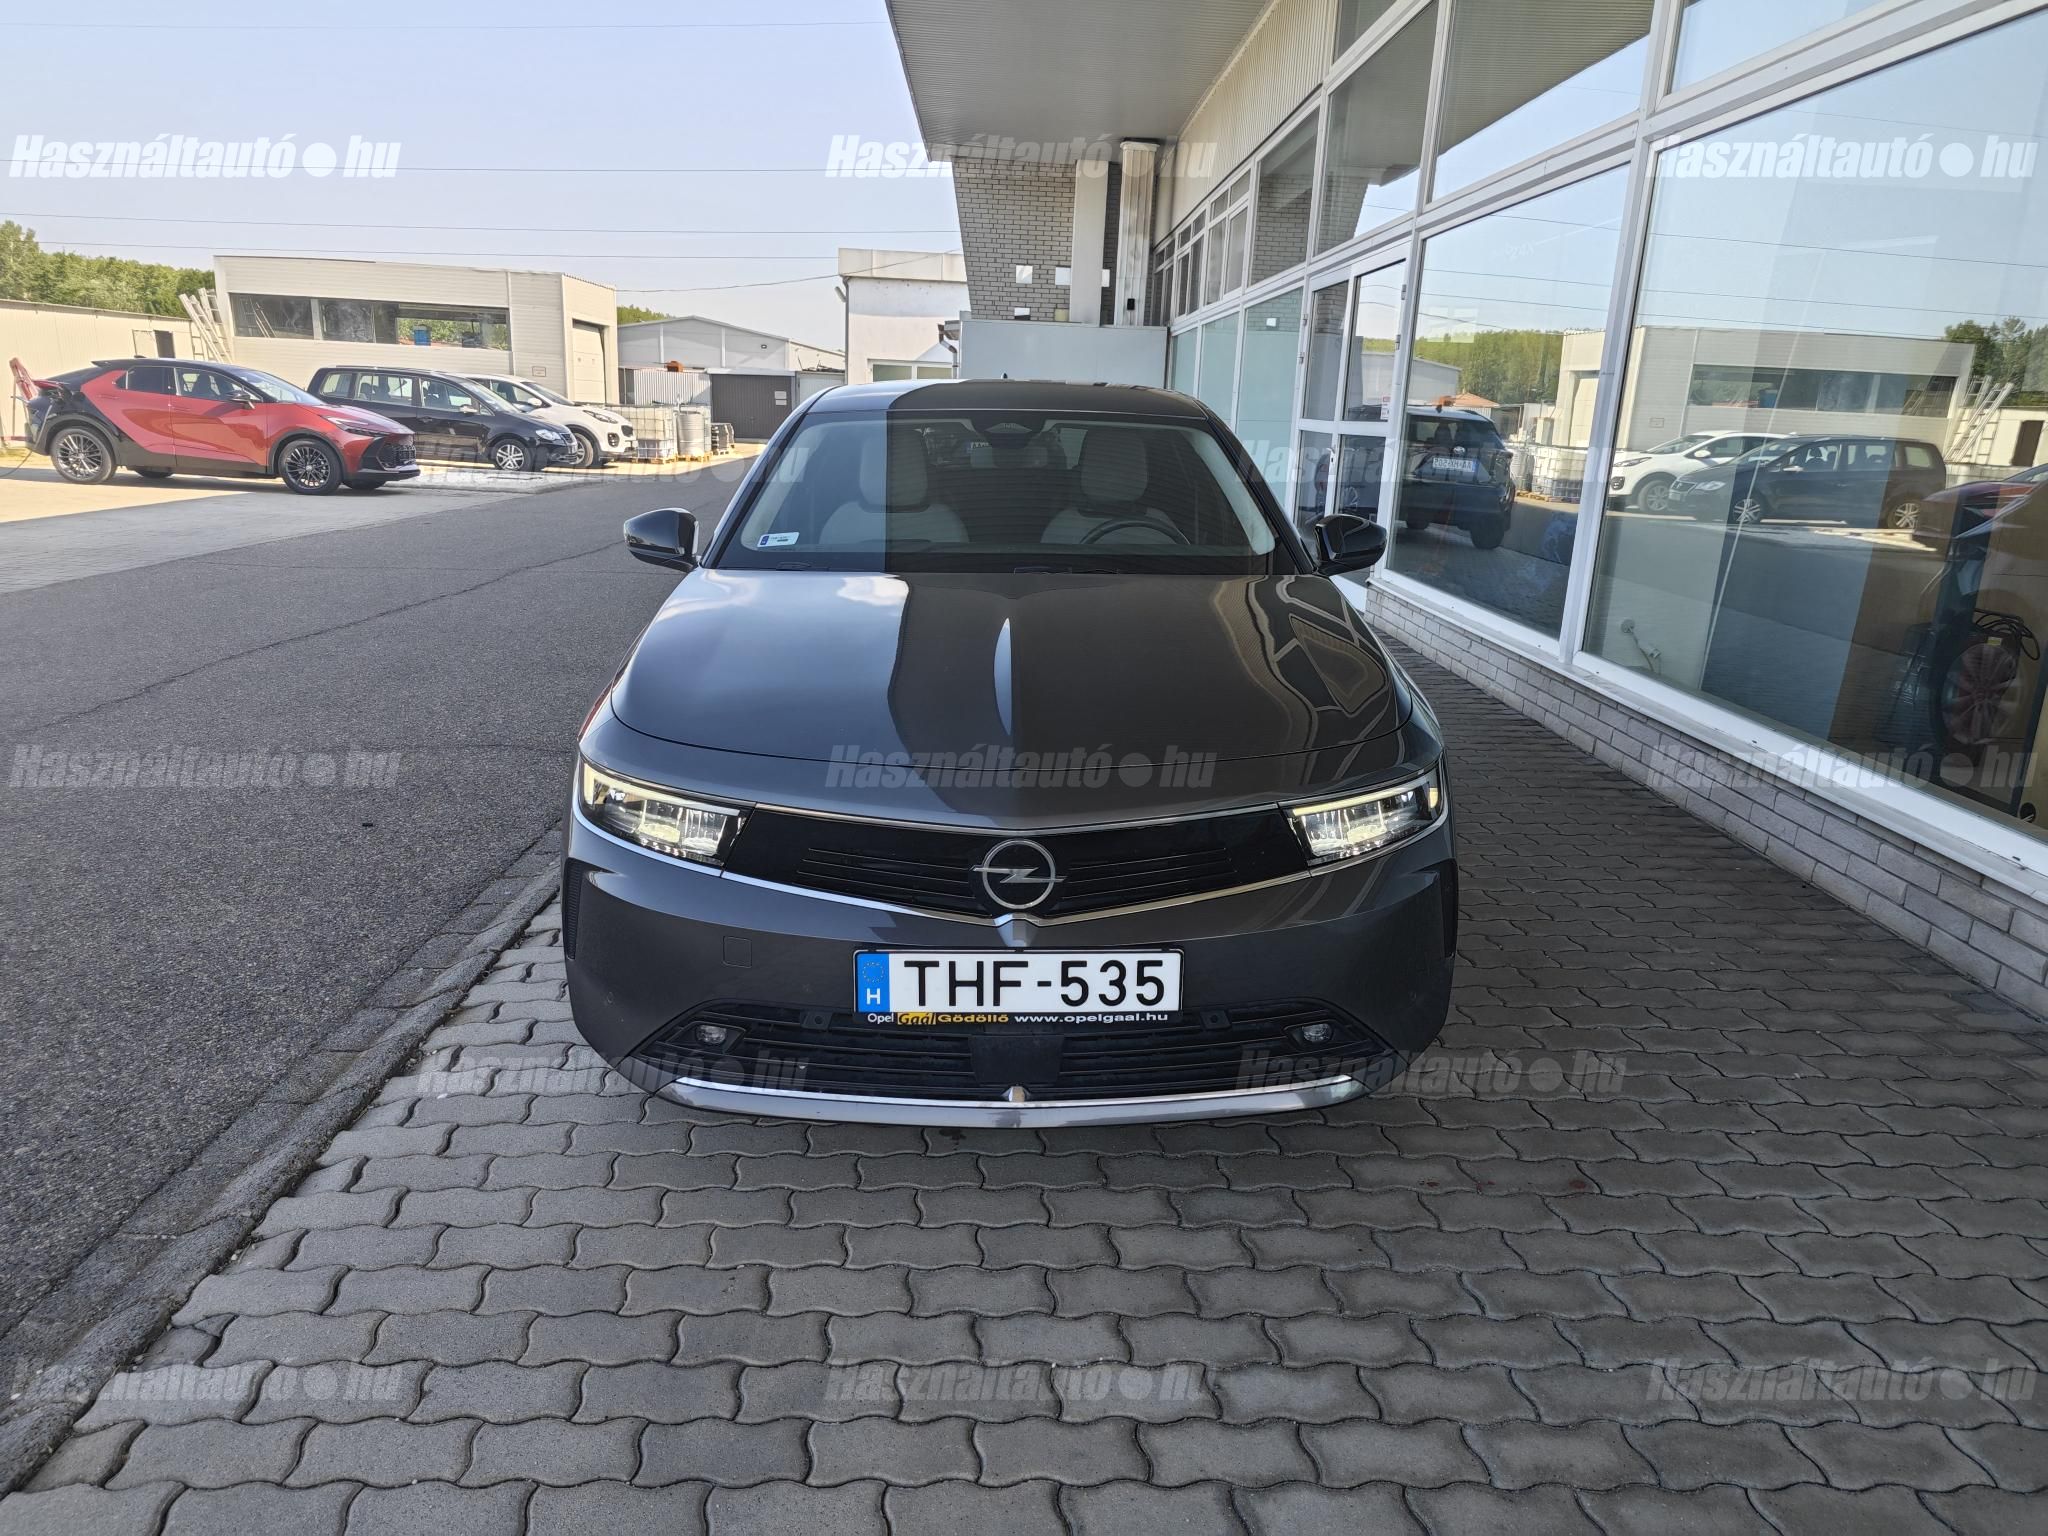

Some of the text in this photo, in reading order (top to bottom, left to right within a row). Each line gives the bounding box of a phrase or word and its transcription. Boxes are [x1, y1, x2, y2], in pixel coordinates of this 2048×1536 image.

[904, 960, 1165, 1007] THF-535
[866, 988, 881, 1005] H
[867, 1013, 894, 1024] Opel
[1014, 1013, 1168, 1024] www.opelgaal.hu
